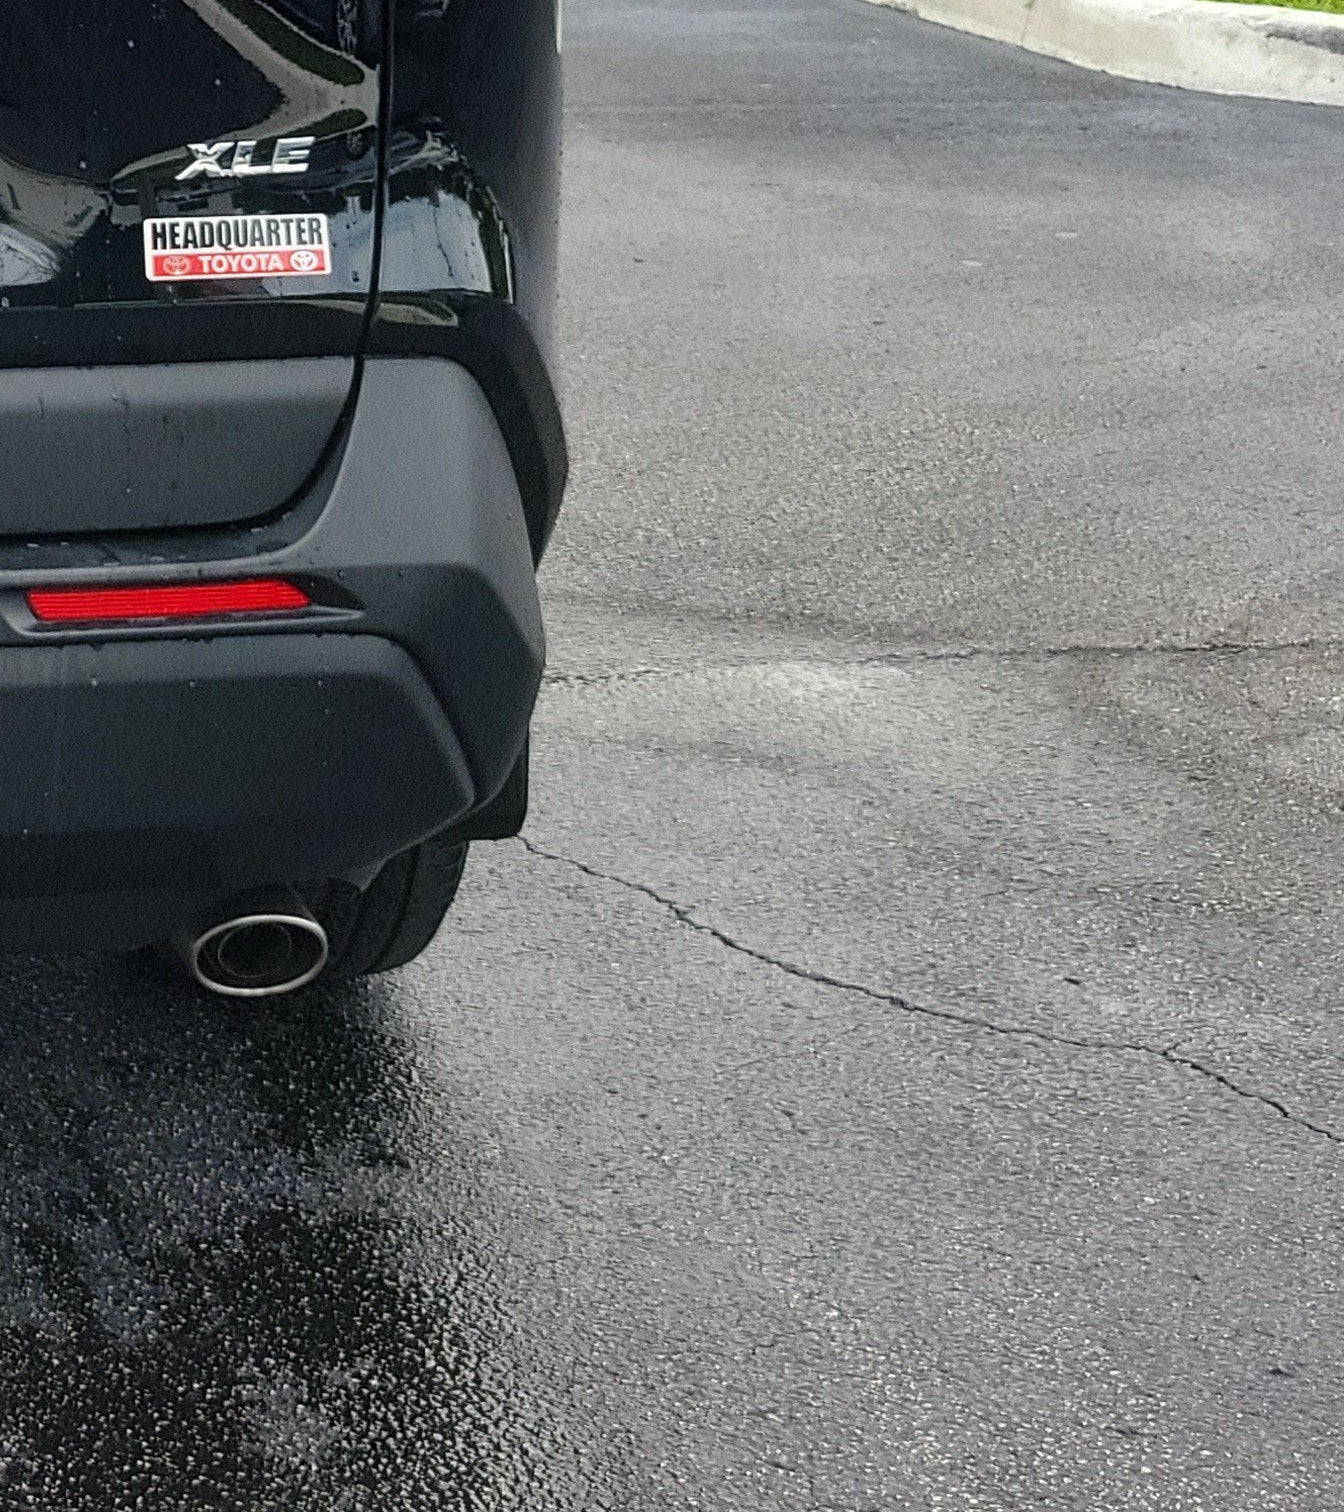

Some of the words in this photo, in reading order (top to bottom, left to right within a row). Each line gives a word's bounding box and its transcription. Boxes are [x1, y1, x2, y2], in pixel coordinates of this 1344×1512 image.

[175, 136, 316, 181] XLE
[151, 217, 323, 251] HEADQUARTER
[198, 253, 285, 274] TOYOTA
